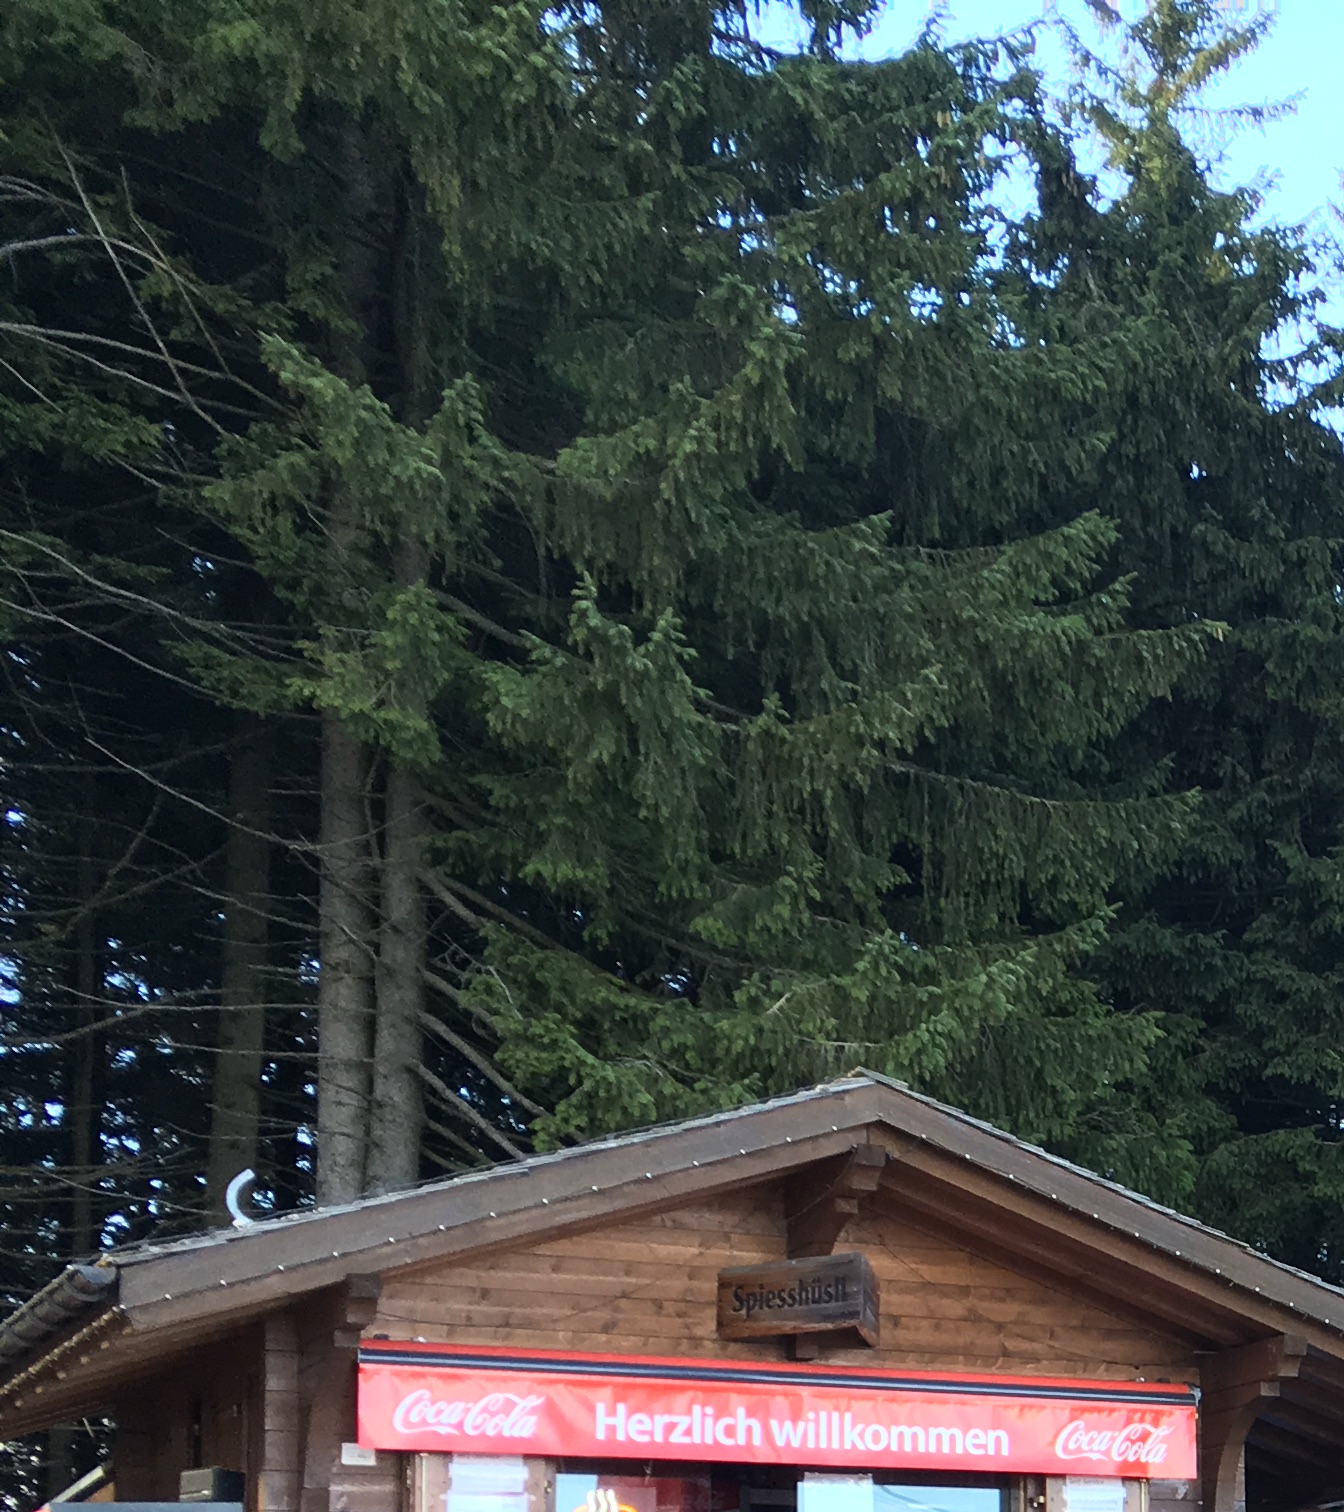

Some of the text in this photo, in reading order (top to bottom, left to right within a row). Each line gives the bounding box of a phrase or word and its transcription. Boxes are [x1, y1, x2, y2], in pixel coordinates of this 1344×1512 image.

[393, 1388, 546, 1438] Coca-Cola
[595, 1402, 1010, 1457] Herzlich willkommen
[1055, 1419, 1176, 1463] Coca-Cola
